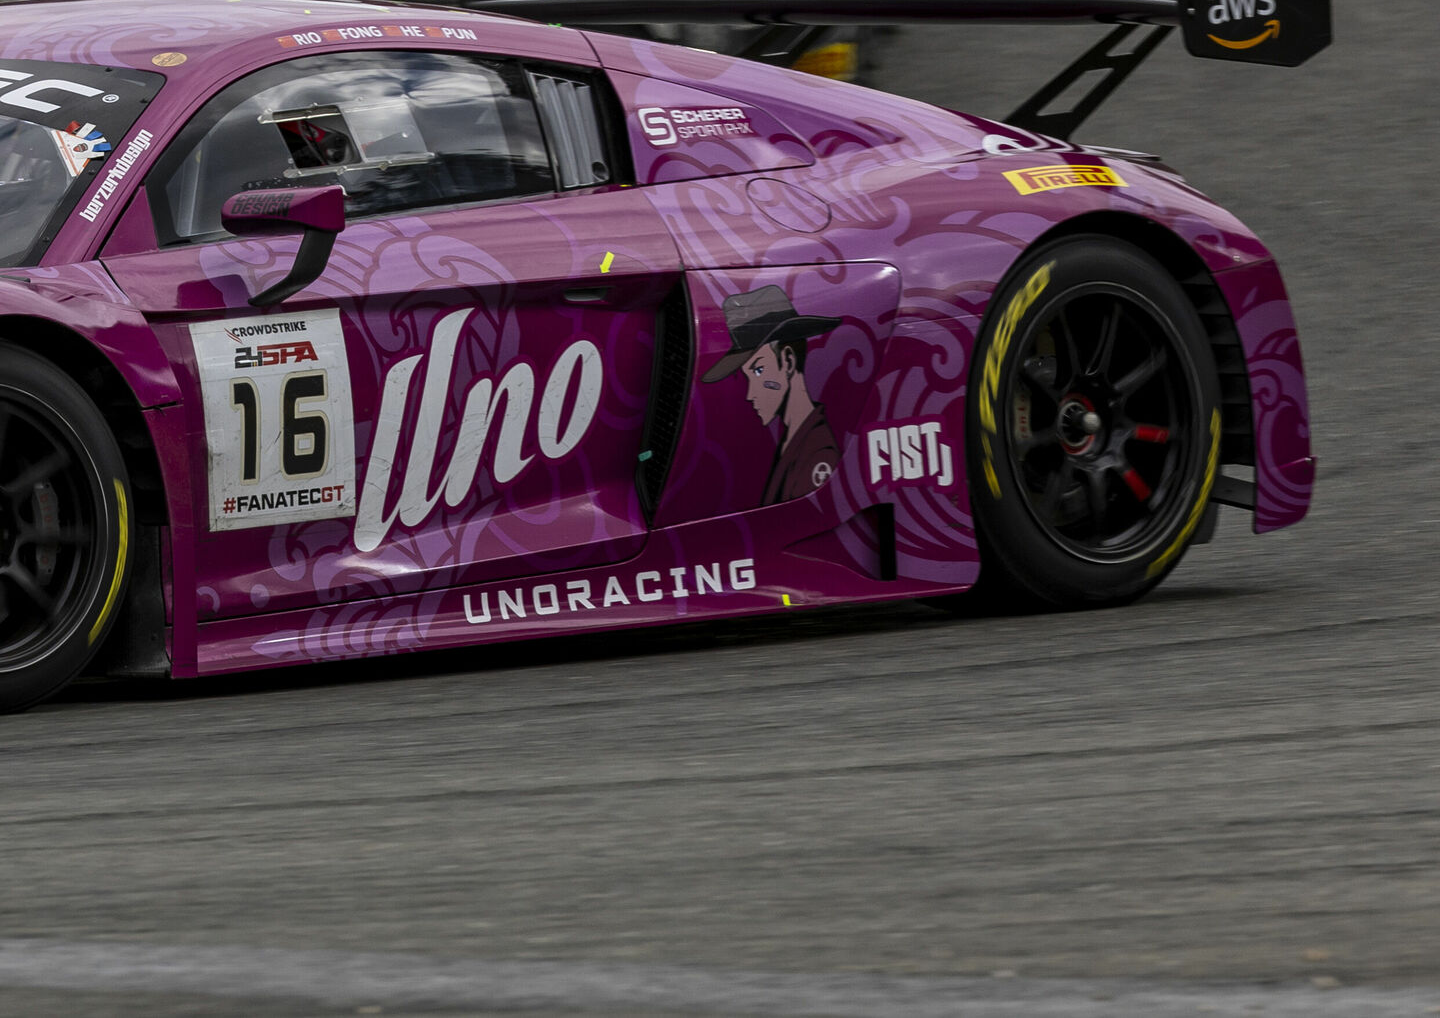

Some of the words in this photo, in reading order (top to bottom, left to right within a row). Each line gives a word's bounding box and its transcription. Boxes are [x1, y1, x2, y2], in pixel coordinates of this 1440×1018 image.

[292, 32, 322, 46] RIO
[337, 26, 382, 40] FONG
[400, 26, 424, 38] HE
[441, 27, 477, 40] PUN
[670, 108, 746, 123] SCHERER
[677, 124, 723, 139] SPORT
[724, 122, 754, 135] PHX
[1017, 166, 1116, 190] PIRELLI
[230, 202, 290, 217] DESIGN
[232, 321, 307, 338] CROWDSTRIKE
[232, 374, 326, 481] 16
[354, 307, 603, 553] Uno
[223, 485, 345, 514] #FANATECGT
[463, 558, 756, 624] UNORACING
